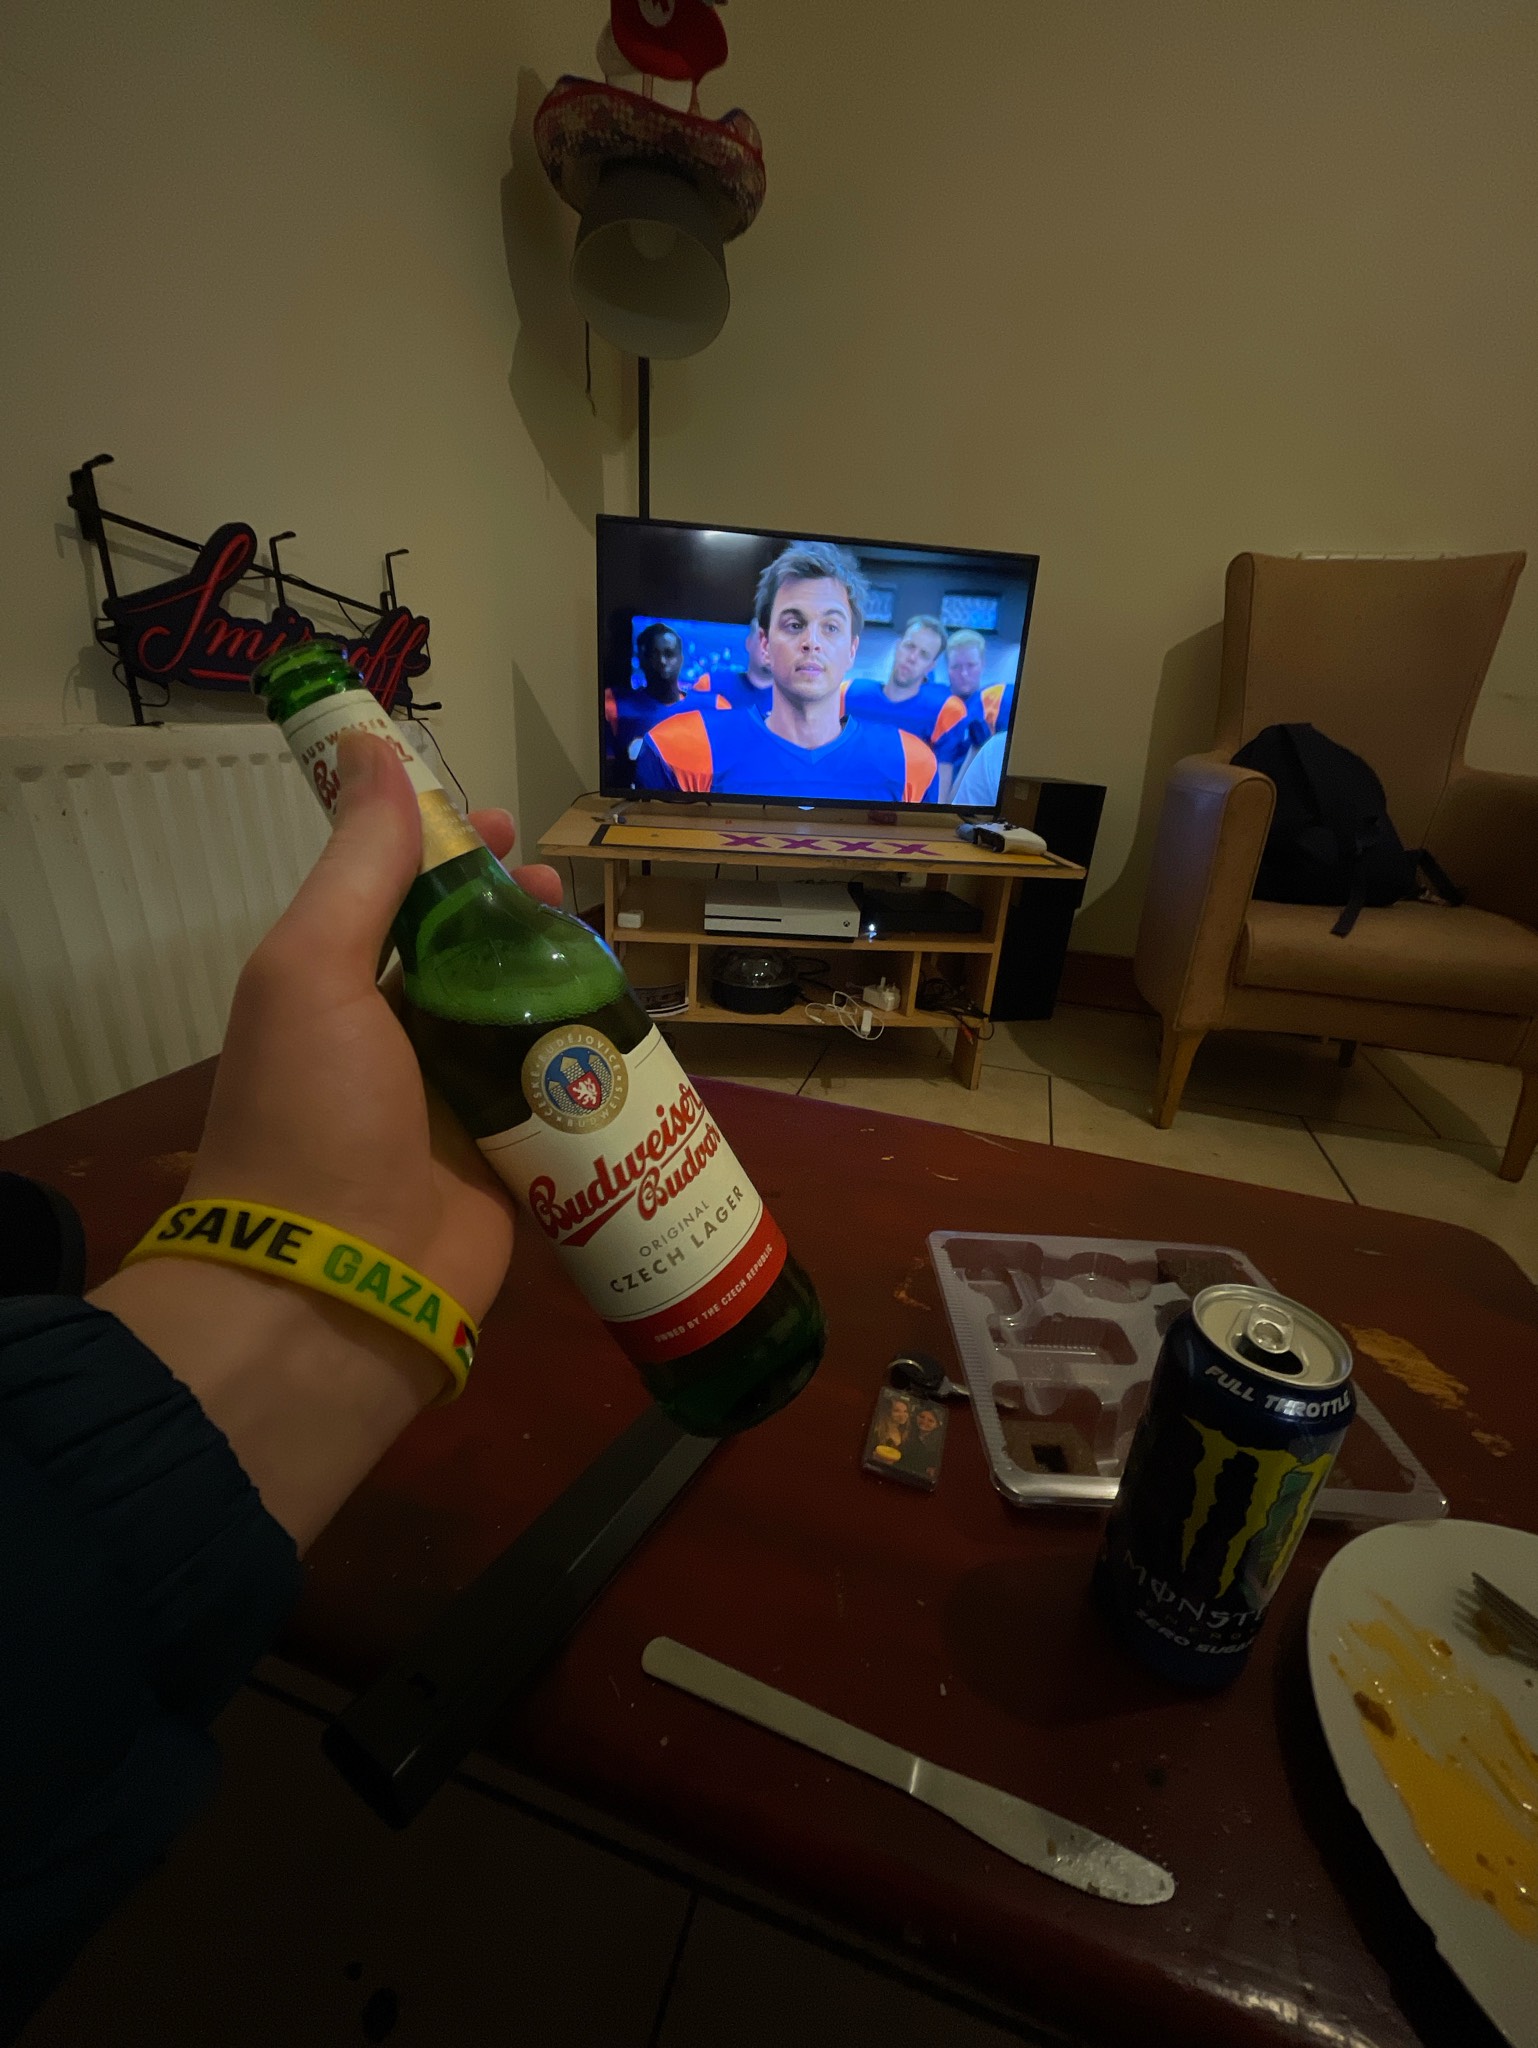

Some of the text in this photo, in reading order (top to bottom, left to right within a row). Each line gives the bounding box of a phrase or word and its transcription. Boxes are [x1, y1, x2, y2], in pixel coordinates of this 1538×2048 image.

[123, 532, 430, 711] Smioff
[718, 833, 944, 857] XXXX
[528, 1083, 705, 1242] Budweiser
[637, 1123, 721, 1221] Budvar
[157, 1206, 442, 1335] SAVE GAZA
[609, 1184, 745, 1294] CZECH LAGER
[638, 1199, 710, 1258] ORIGINAL
[686, 1316, 701, 1329] BY
[701, 1303, 721, 1320] THE
[720, 1278, 747, 1306] CZECH
[745, 1243, 774, 1282] REPUBLIC
[1204, 1364, 1351, 1418] FULL THROTTLE
[1122, 1549, 1268, 1629] MONST
